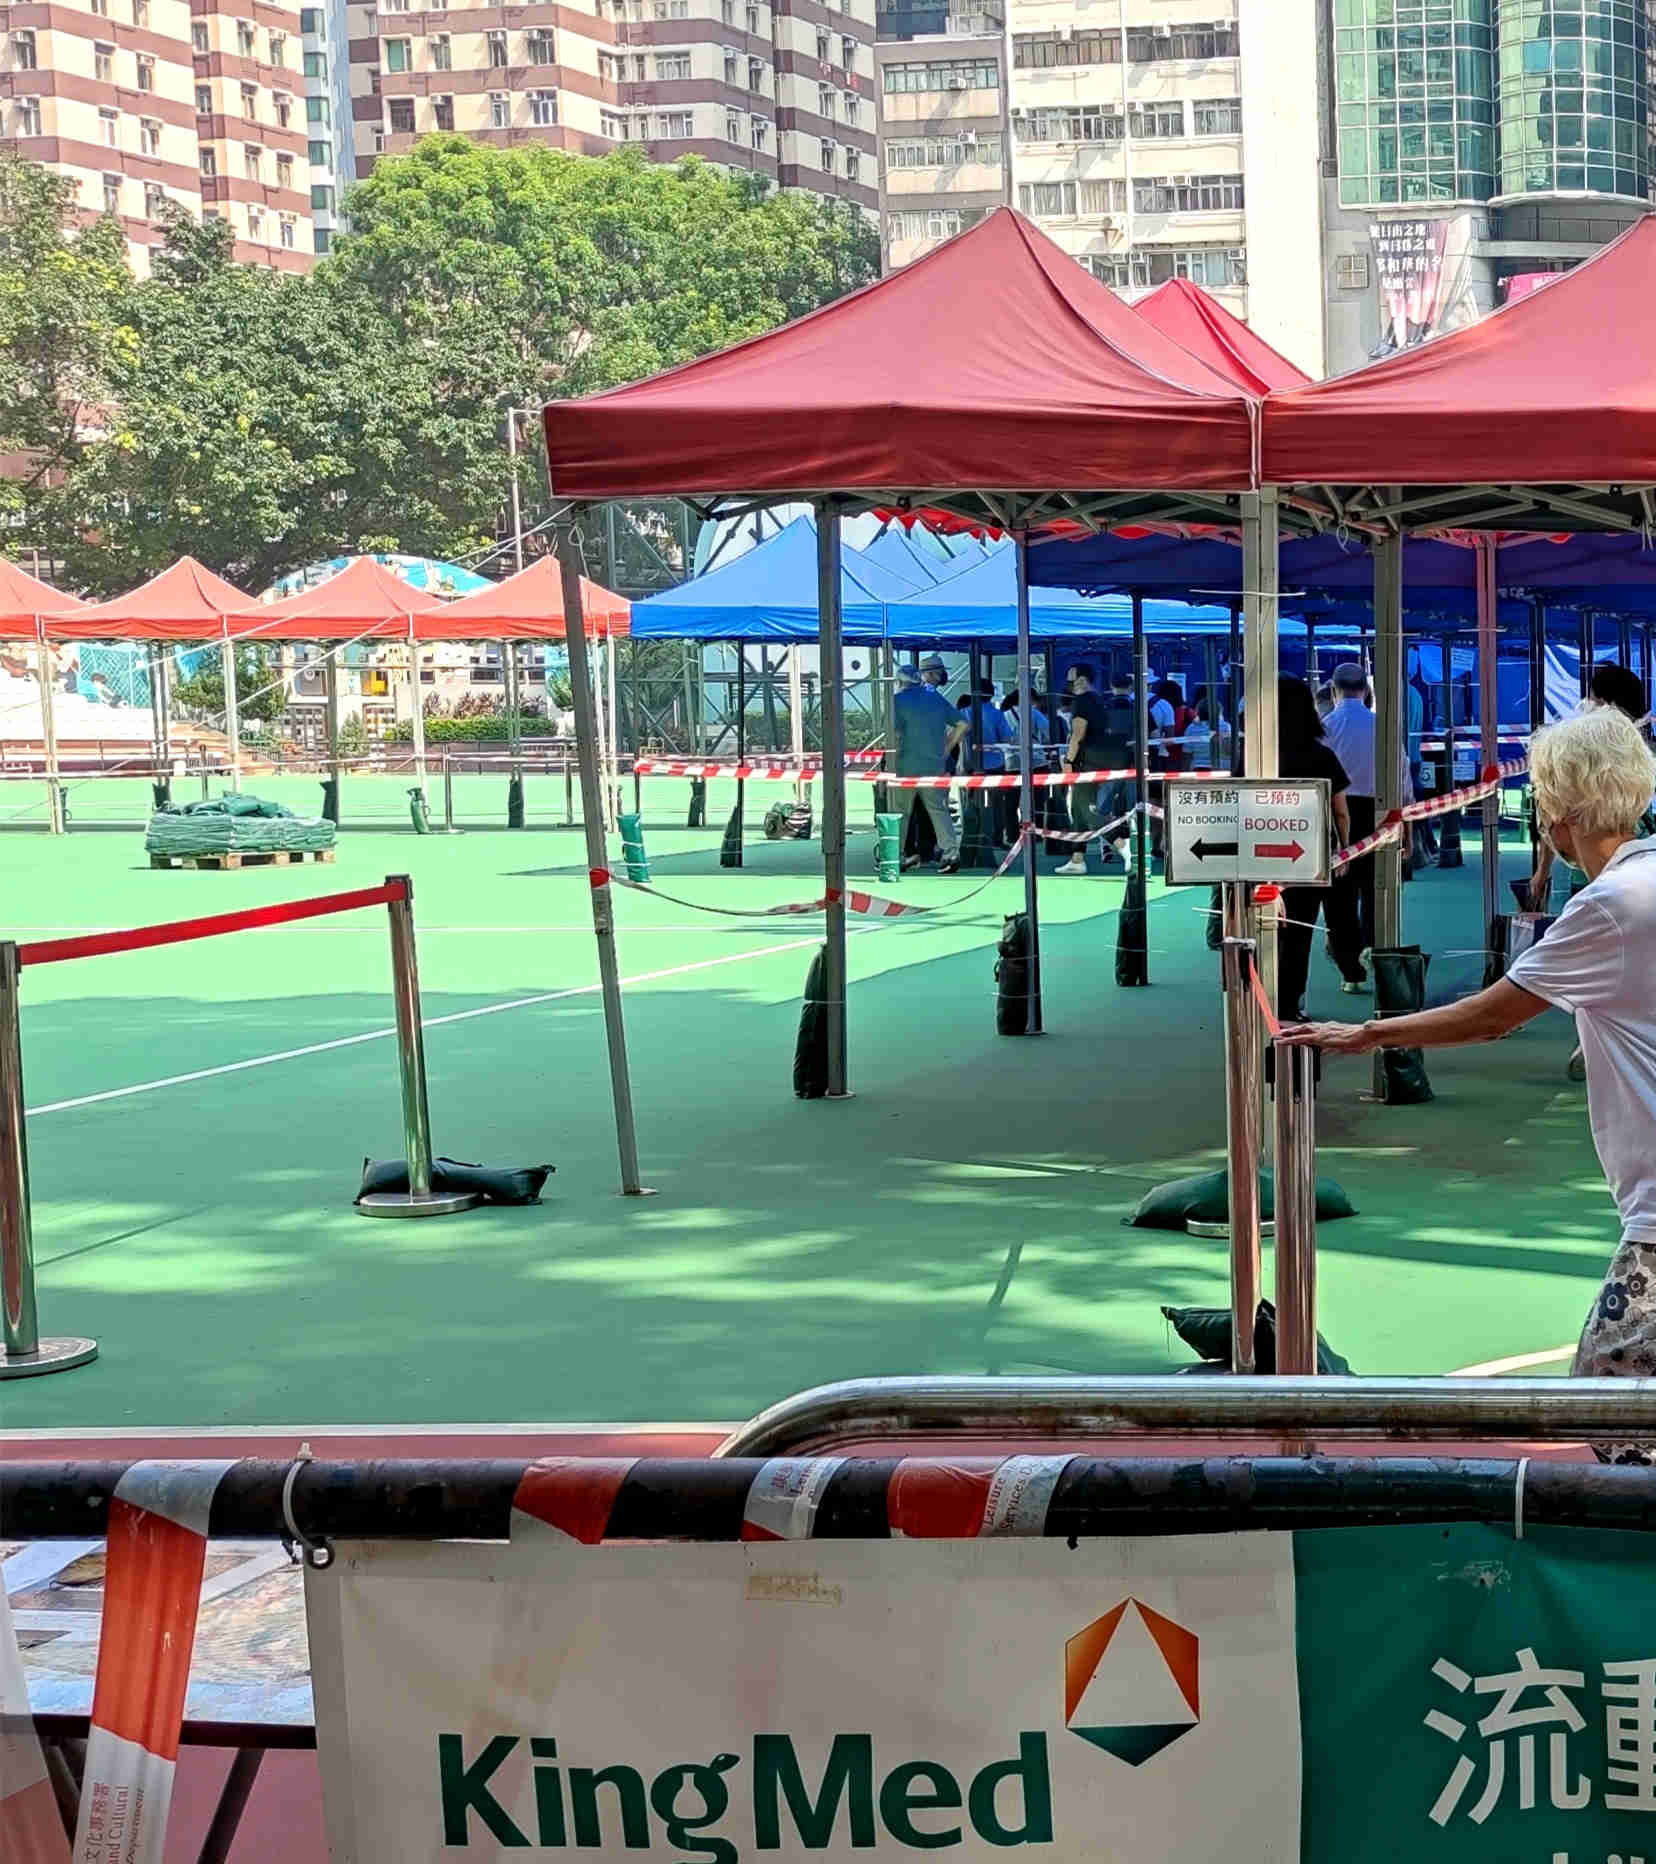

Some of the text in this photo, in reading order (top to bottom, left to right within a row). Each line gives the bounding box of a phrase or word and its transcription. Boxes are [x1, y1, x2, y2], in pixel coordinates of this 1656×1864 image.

[1178, 790, 1239, 805] 沒有預約
[1255, 790, 1300, 805] 已預約
[1177, 816, 1239, 825] NO BOOKING
[1244, 818, 1309, 831] BOOKED
[438, 1731, 1055, 1864] KingMed
